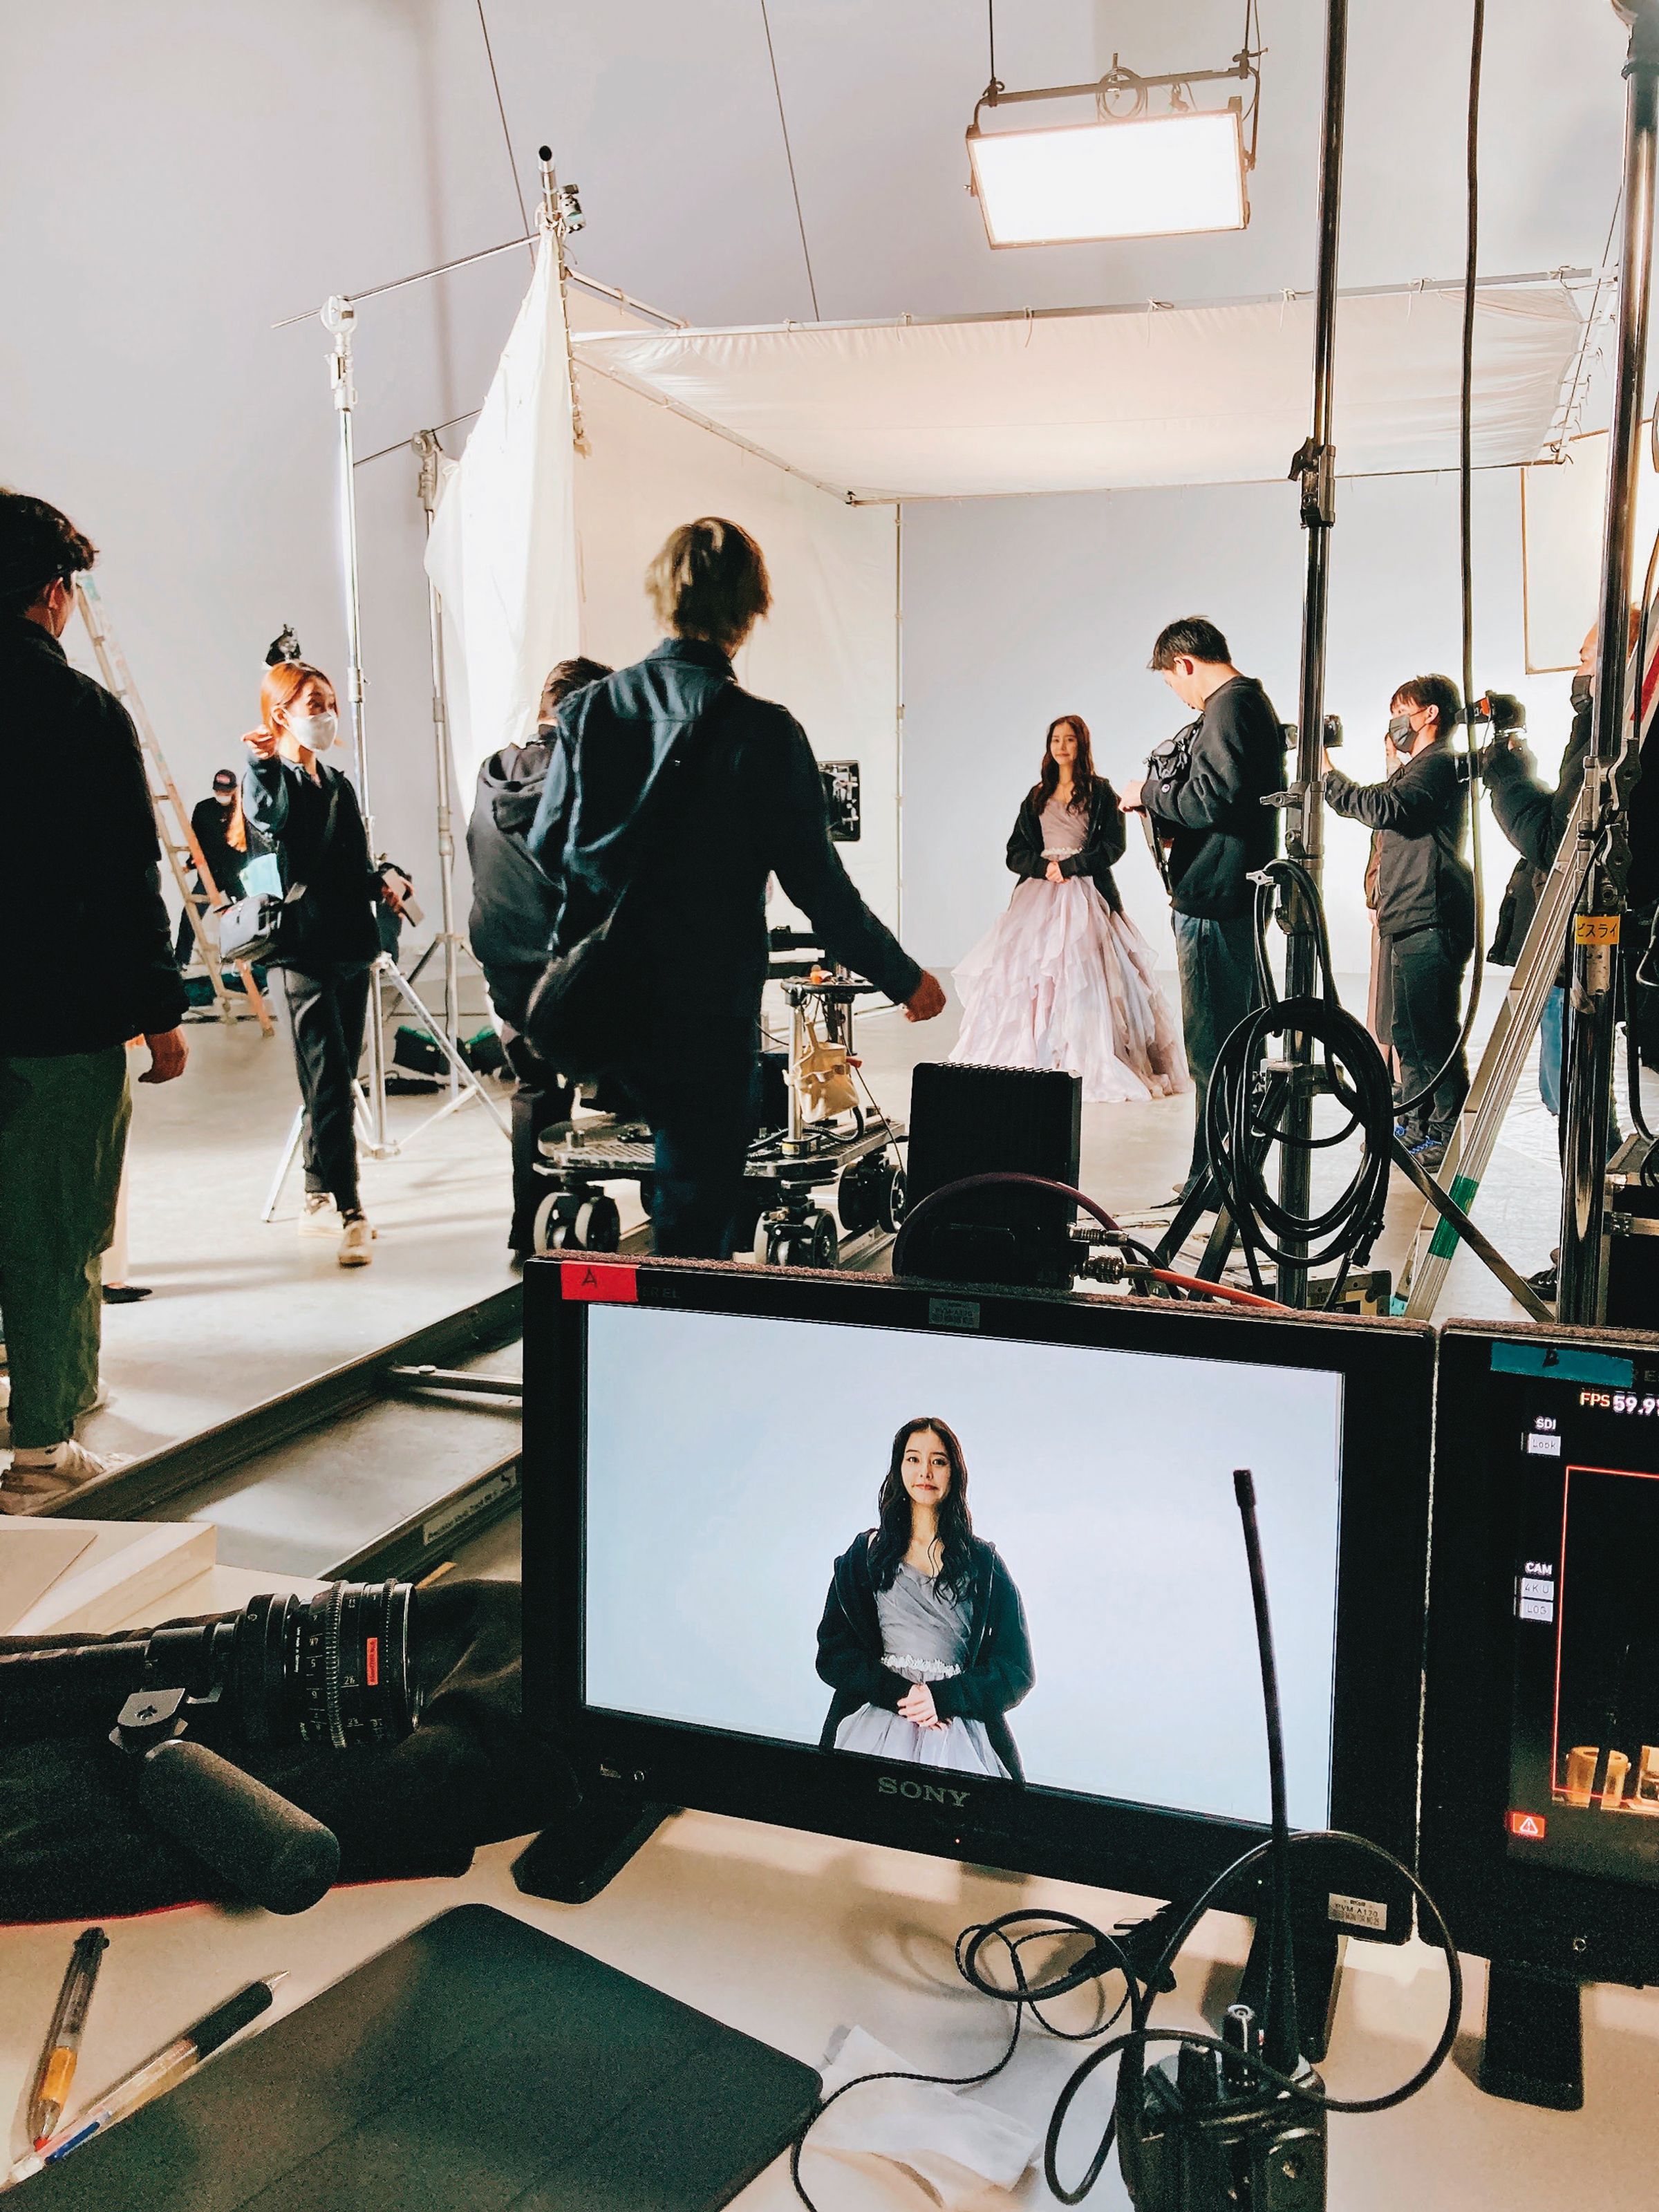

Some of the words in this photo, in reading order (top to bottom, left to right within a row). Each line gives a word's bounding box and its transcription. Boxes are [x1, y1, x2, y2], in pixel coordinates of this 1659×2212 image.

[581, 1268, 597, 1288] A
[1580, 1391, 1611, 1407] FPS
[1612, 1394, 1659, 1416] 59.9
[1535, 1418, 1557, 1430] SDI
[1533, 1438, 1557, 1449] Look
[1525, 1562, 1553, 1575] CAM
[1527, 1604, 1547, 1615] LOG
[877, 1776, 971, 1808] SONY
